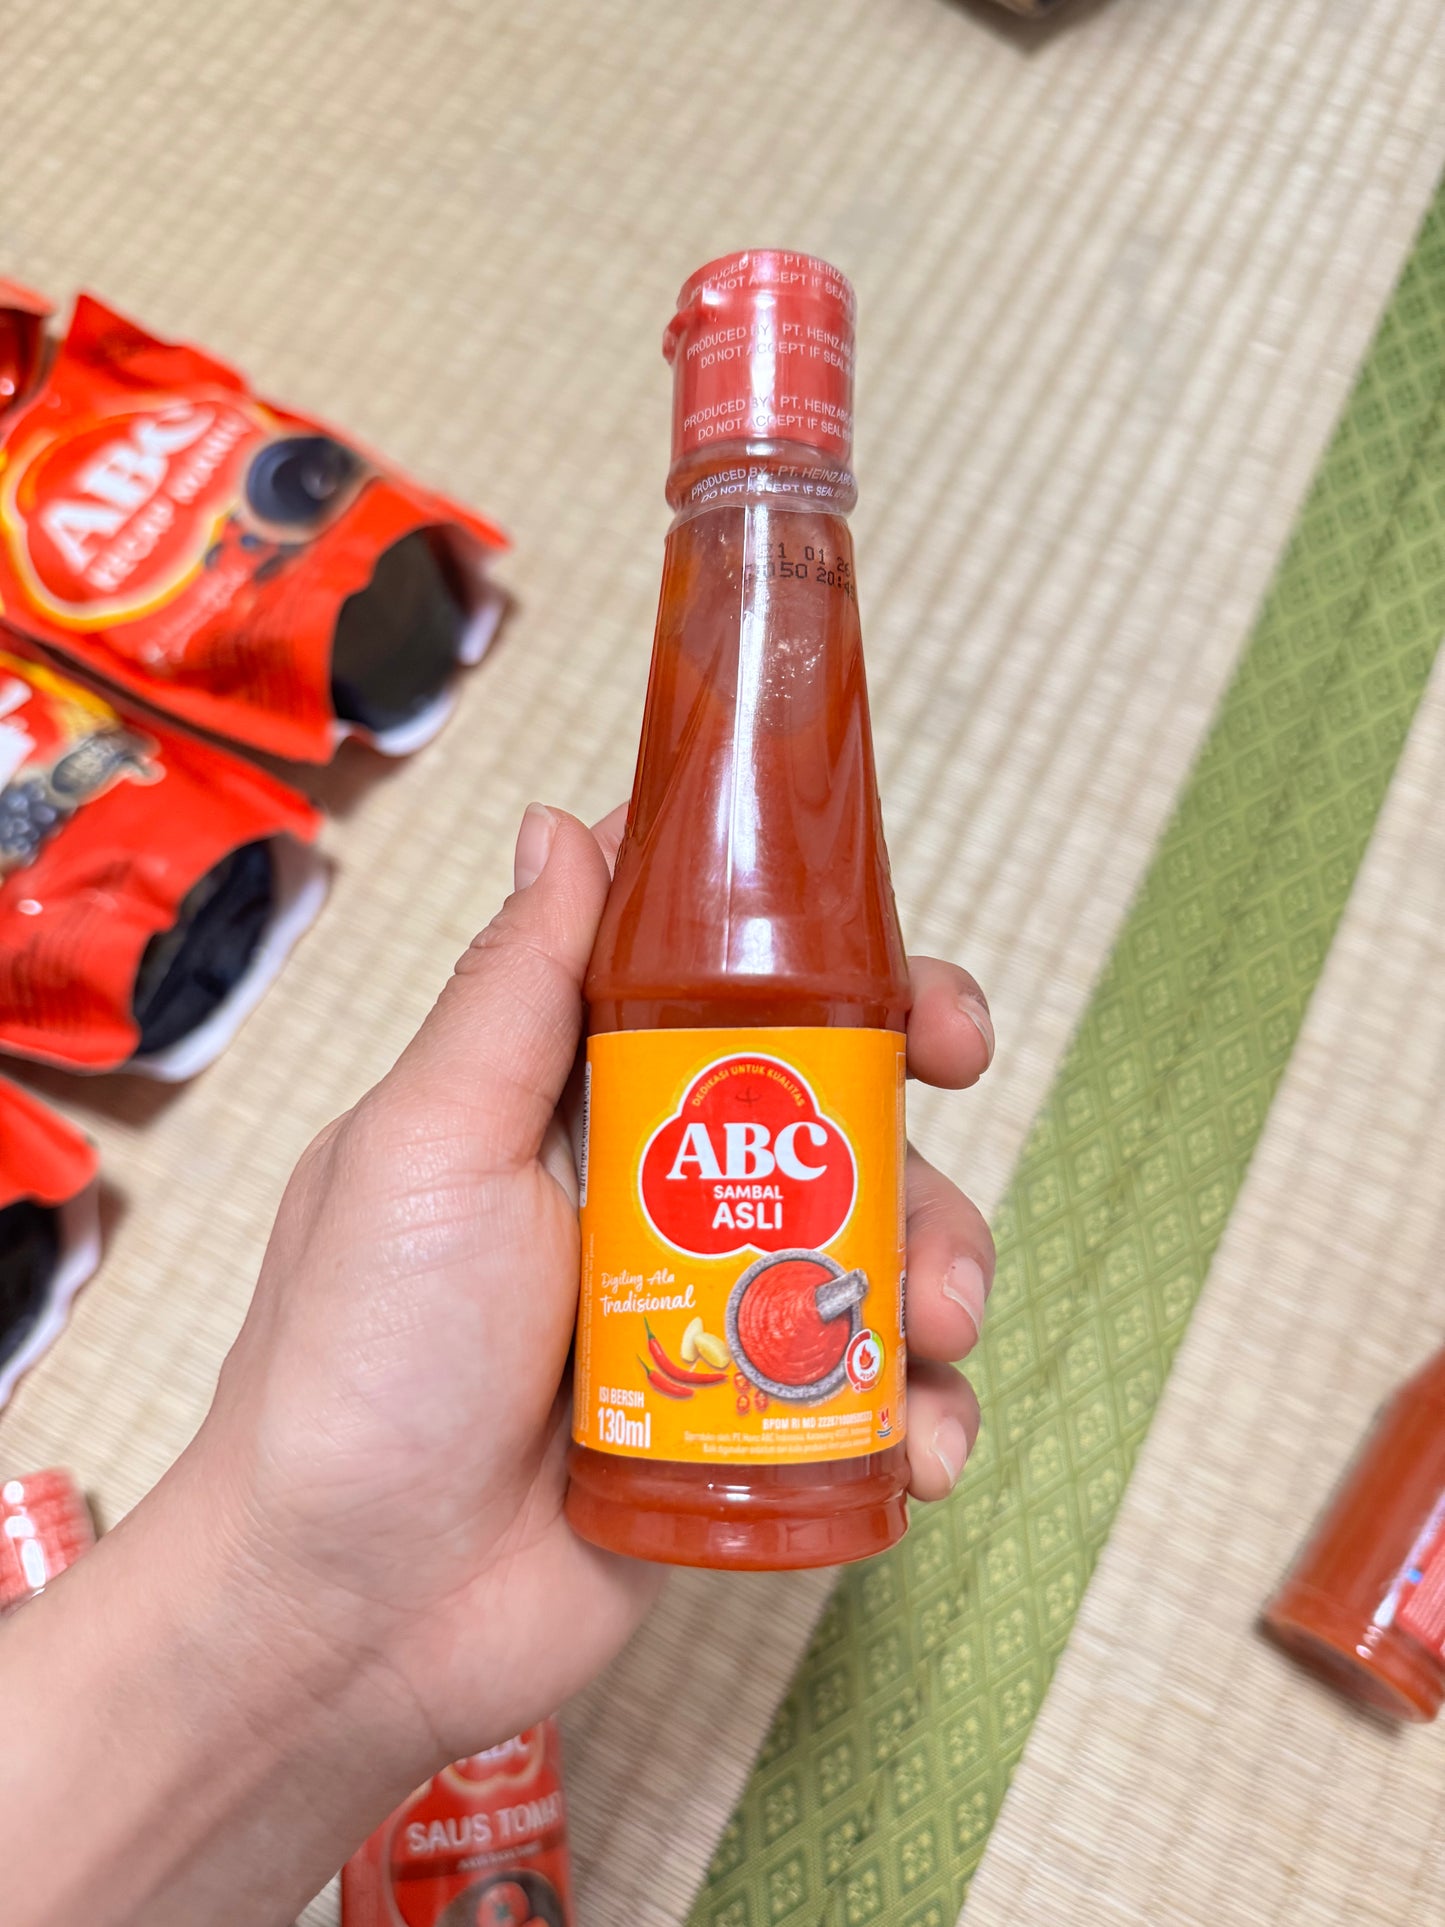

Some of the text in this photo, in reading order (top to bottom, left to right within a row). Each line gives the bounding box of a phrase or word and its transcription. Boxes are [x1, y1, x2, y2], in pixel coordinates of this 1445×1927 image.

[716, 276, 744, 291] NOT
[687, 326, 747, 360] PRODUCED
[782, 323, 803, 337] PT.
[807, 325, 840, 350] HEINZ
[701, 353, 715, 369] DO
[717, 345, 743, 362] NOT
[810, 345, 821, 359] IF
[823, 349, 845, 372] SEAL
[683, 398, 747, 432] PRODUCED
[780, 394, 801, 409] PT.
[804, 397, 836, 418] HEINZ
[698, 425, 714, 441] DO
[716, 417, 743, 434] NOT
[808, 416, 818, 430] IF
[821, 420, 841, 438] SEAL
[40, 398, 216, 574] ABC
[691, 468, 747, 501] PRODUCED
[749, 466, 768, 478] BY
[778, 465, 799, 477] PT.
[802, 467, 839, 483] HEINZ
[720, 484, 745, 496] NOT
[802, 484, 814, 495] IF
[815, 485, 834, 497] SEAL
[804, 546, 826, 565] 01
[691, 1063, 806, 1108] DEDIKASI UNTUK KUALITAS
[665, 1121, 829, 1181] ABC
[713, 1184, 784, 1200] SAMBAL
[711, 1201, 783, 1230] ASLI
[647, 1267, 676, 1286] Ala
[598, 1385, 645, 1409] ISI BERSIH
[597, 1406, 651, 1449] 130ml
[406, 1814, 493, 1856] SAUS
